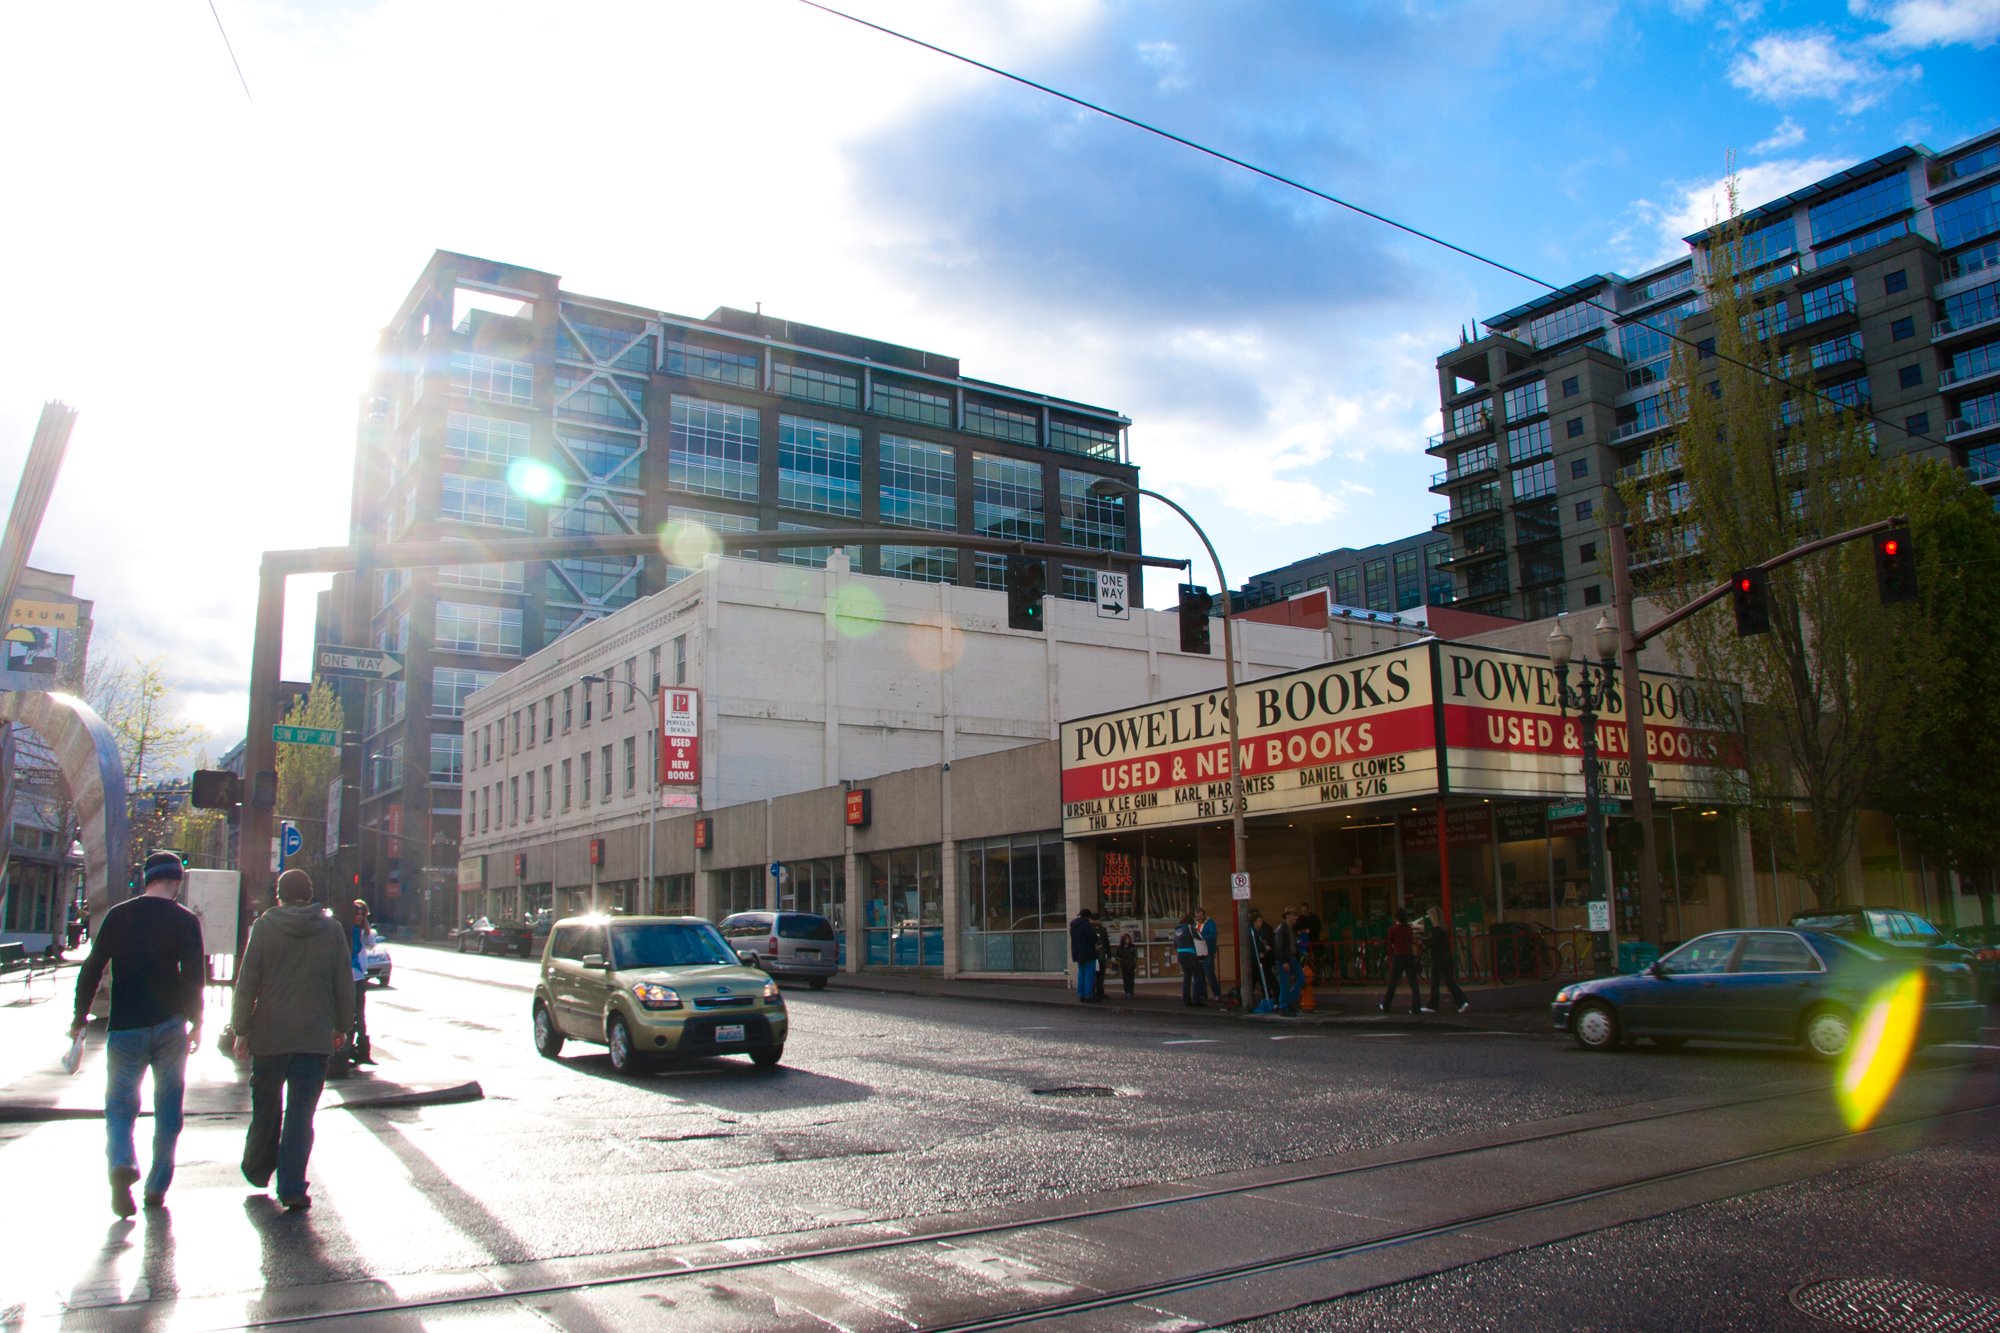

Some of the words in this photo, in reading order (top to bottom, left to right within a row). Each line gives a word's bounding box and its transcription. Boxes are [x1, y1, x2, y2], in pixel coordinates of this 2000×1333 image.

[1101, 574, 1123, 587] ONE
[1101, 587, 1124, 600] WAY
[323, 654, 349, 668] ONE
[356, 657, 382, 670] WAY
[1075, 694, 1239, 761] POWELL'S
[1256, 659, 1411, 728] BOOKS
[666, 719, 695, 727] POWELL'S
[276, 729, 291, 740] SW
[319, 733, 333, 743] AV
[671, 738, 691, 747] USED
[1487, 714, 1553, 747] USED
[1563, 722, 1580, 750] &
[1646, 730, 1718, 759] BOOKS
[677, 749, 685, 759] &
[1102, 760, 1161, 791] USED
[1171, 756, 1187, 781] &
[1196, 743, 1255, 777] NEW
[1267, 722, 1374, 767] BOOKS
[671, 760, 690, 770] NEW
[1299, 765, 1344, 787] DANIEL
[1352, 755, 1406, 778] CLOWES
[667, 771, 695, 780] BOOKS
[1174, 786, 1202, 803] KARL
[1207, 775, 1275, 799] MARANTES
[1320, 782, 1349, 802] MON
[1356, 777, 1388, 797] 5/16
[1067, 800, 1103, 817] URSULA
[1108, 798, 1115, 812] K
[1118, 796, 1130, 810] LE
[1134, 792, 1158, 808] GUIN
[1198, 802, 1216, 817] FRI
[1222, 797, 1248, 813] 5/3
[1089, 816, 1107, 830] THU
[1115, 811, 1138, 826] 5/12
[1105, 865, 1131, 876] USED
[1103, 875, 1133, 887] BOOKS
